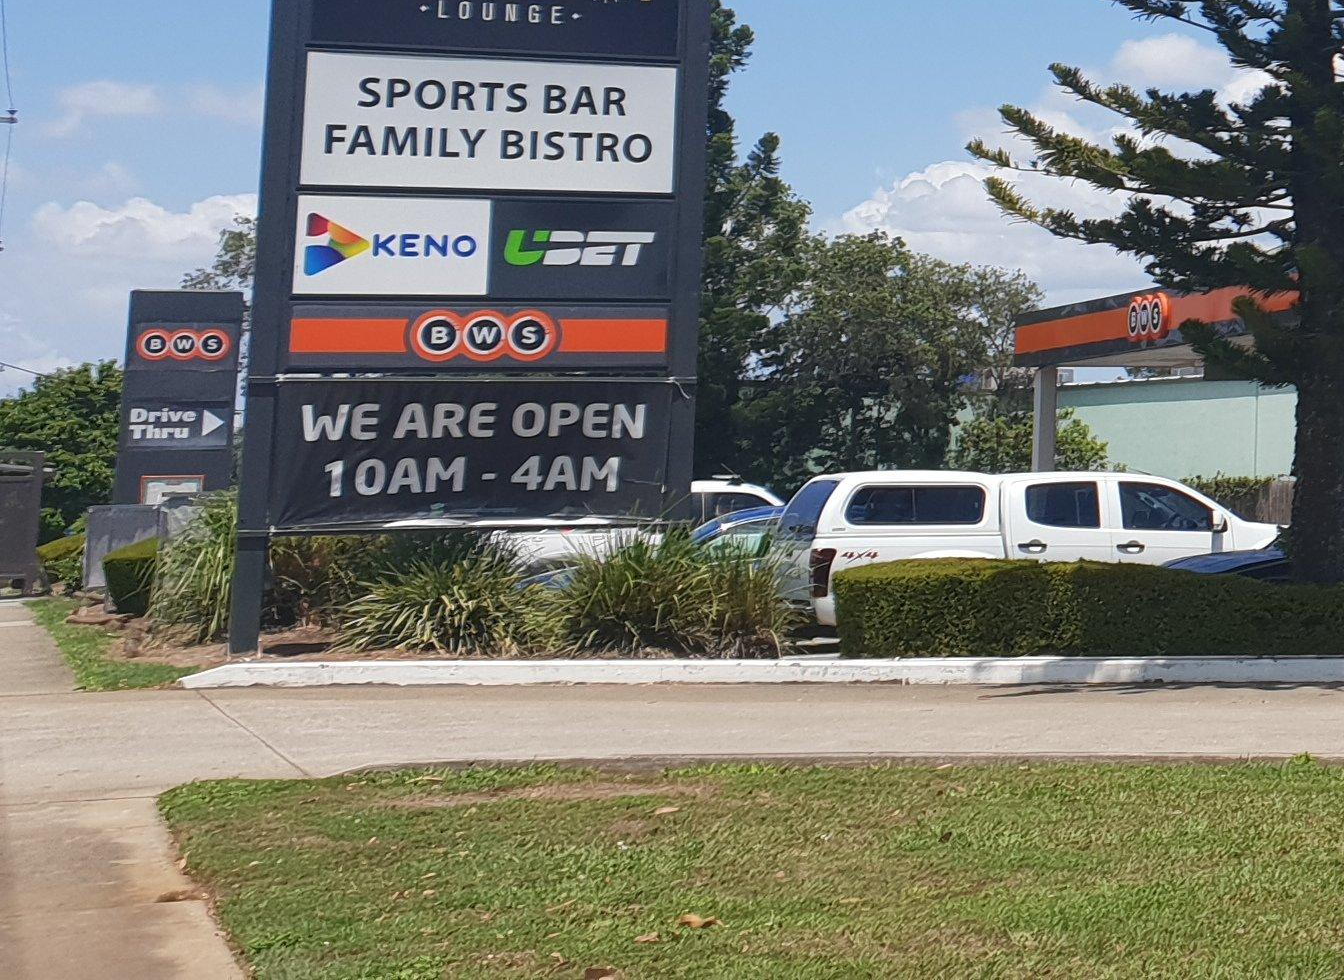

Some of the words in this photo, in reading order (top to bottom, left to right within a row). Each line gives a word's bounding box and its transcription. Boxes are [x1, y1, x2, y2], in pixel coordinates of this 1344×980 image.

[437, 1, 564, 24] LOUNGE
[357, 77, 527, 113] SPORTS
[543, 84, 626, 116] BAR
[324, 124, 486, 159] FAMILY
[500, 129, 653, 163] BISTRO
[373, 233, 477, 257] KENO
[504, 229, 656, 266] UBET
[129, 424, 189, 439] Thru
[130, 407, 197, 423] Drive
[301, 402, 379, 442] WE
[392, 402, 497, 439] ARE
[511, 402, 647, 439] OPEN
[324, 456, 466, 497] 10AM
[510, 455, 622, 493] 4AM
